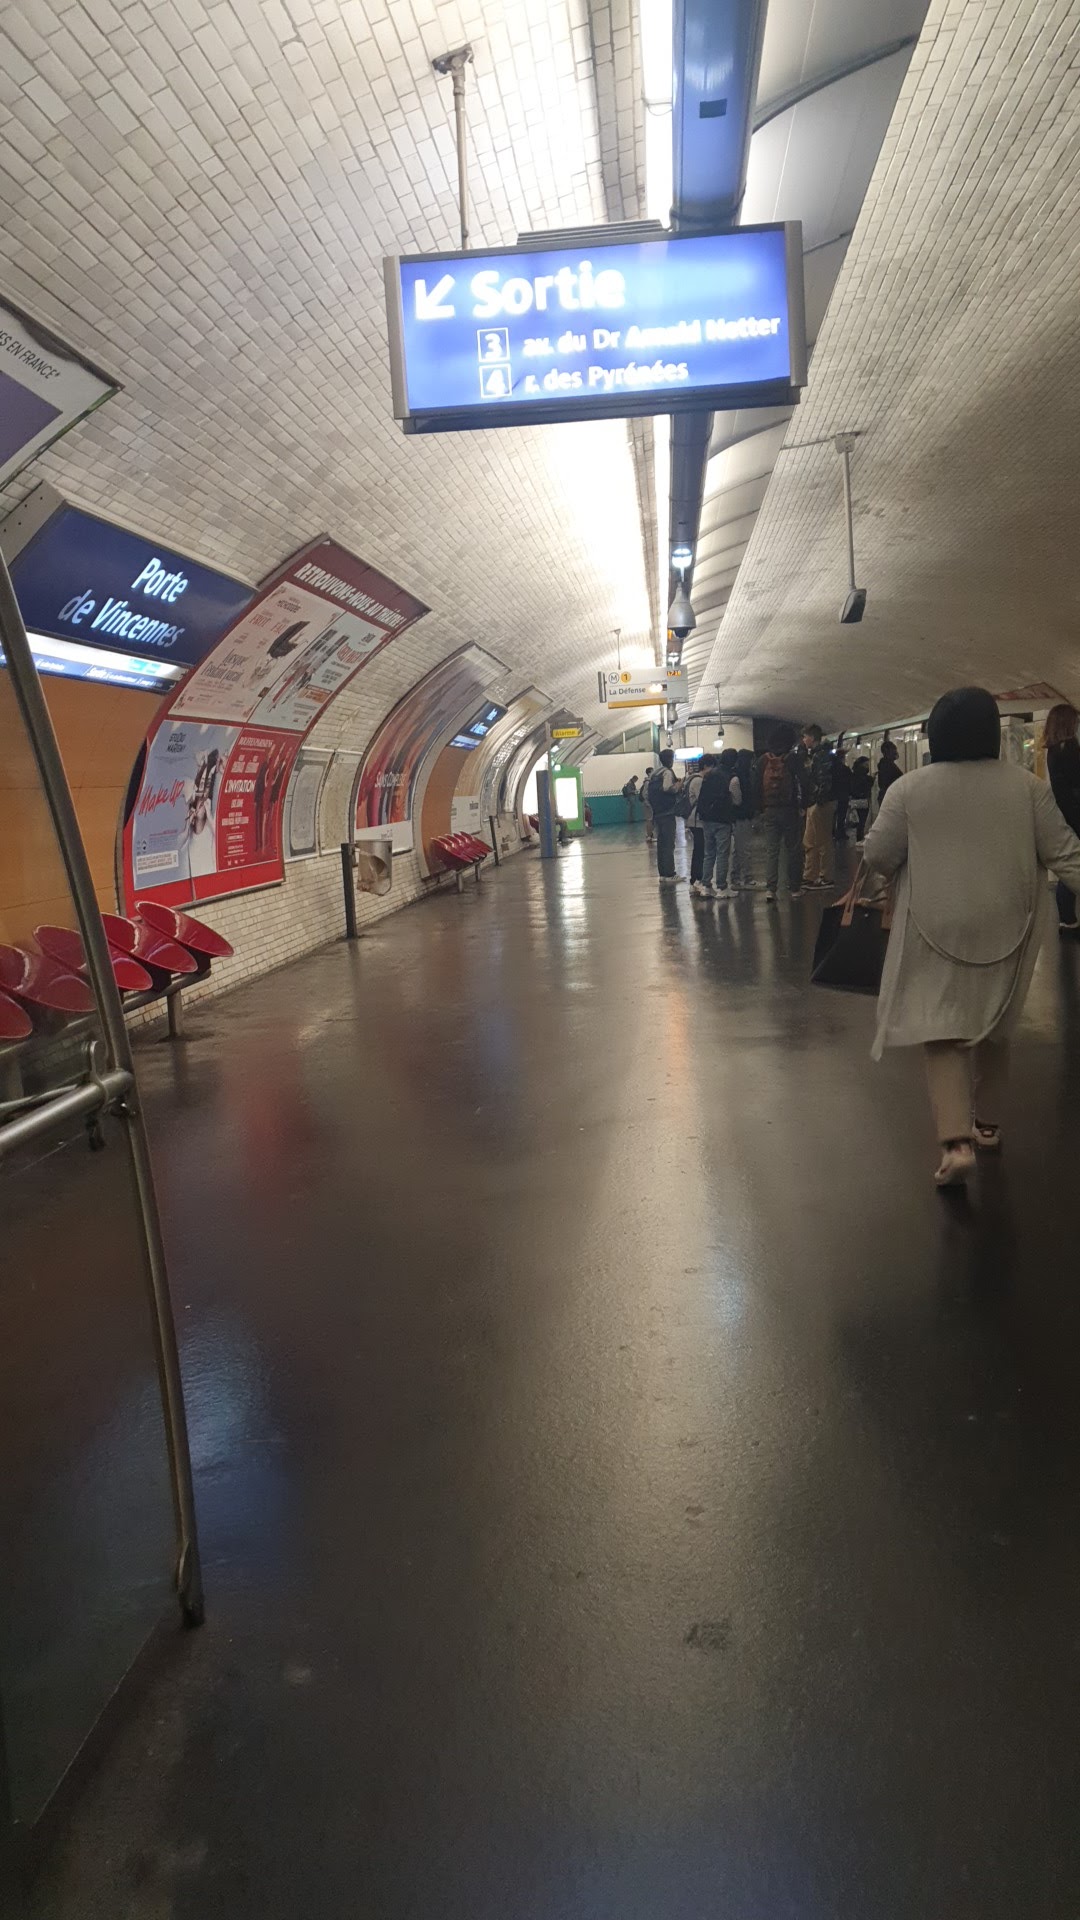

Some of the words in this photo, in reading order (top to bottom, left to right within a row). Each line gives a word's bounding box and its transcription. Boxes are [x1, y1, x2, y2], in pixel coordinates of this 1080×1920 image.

[470, 260, 626, 318] Sortie
[0, 329, 12, 347] ES
[6, 341, 26, 356] EN
[485, 333, 502, 360] 3
[522, 336, 554, 357] av.
[557, 331, 587, 353] du
[593, 329, 620, 349] Dr
[705, 316, 781, 341] Netter
[486, 369, 506, 394] 4
[543, 368, 583, 390] des
[588, 360, 688, 391] Pyrénées
[130, 557, 189, 602] Porte
[293, 562, 376, 612] RETROUVONS-NOUS
[57, 589, 96, 624] de
[90, 597, 186, 647] Vincennes
[618, 686, 647, 695] Défense
